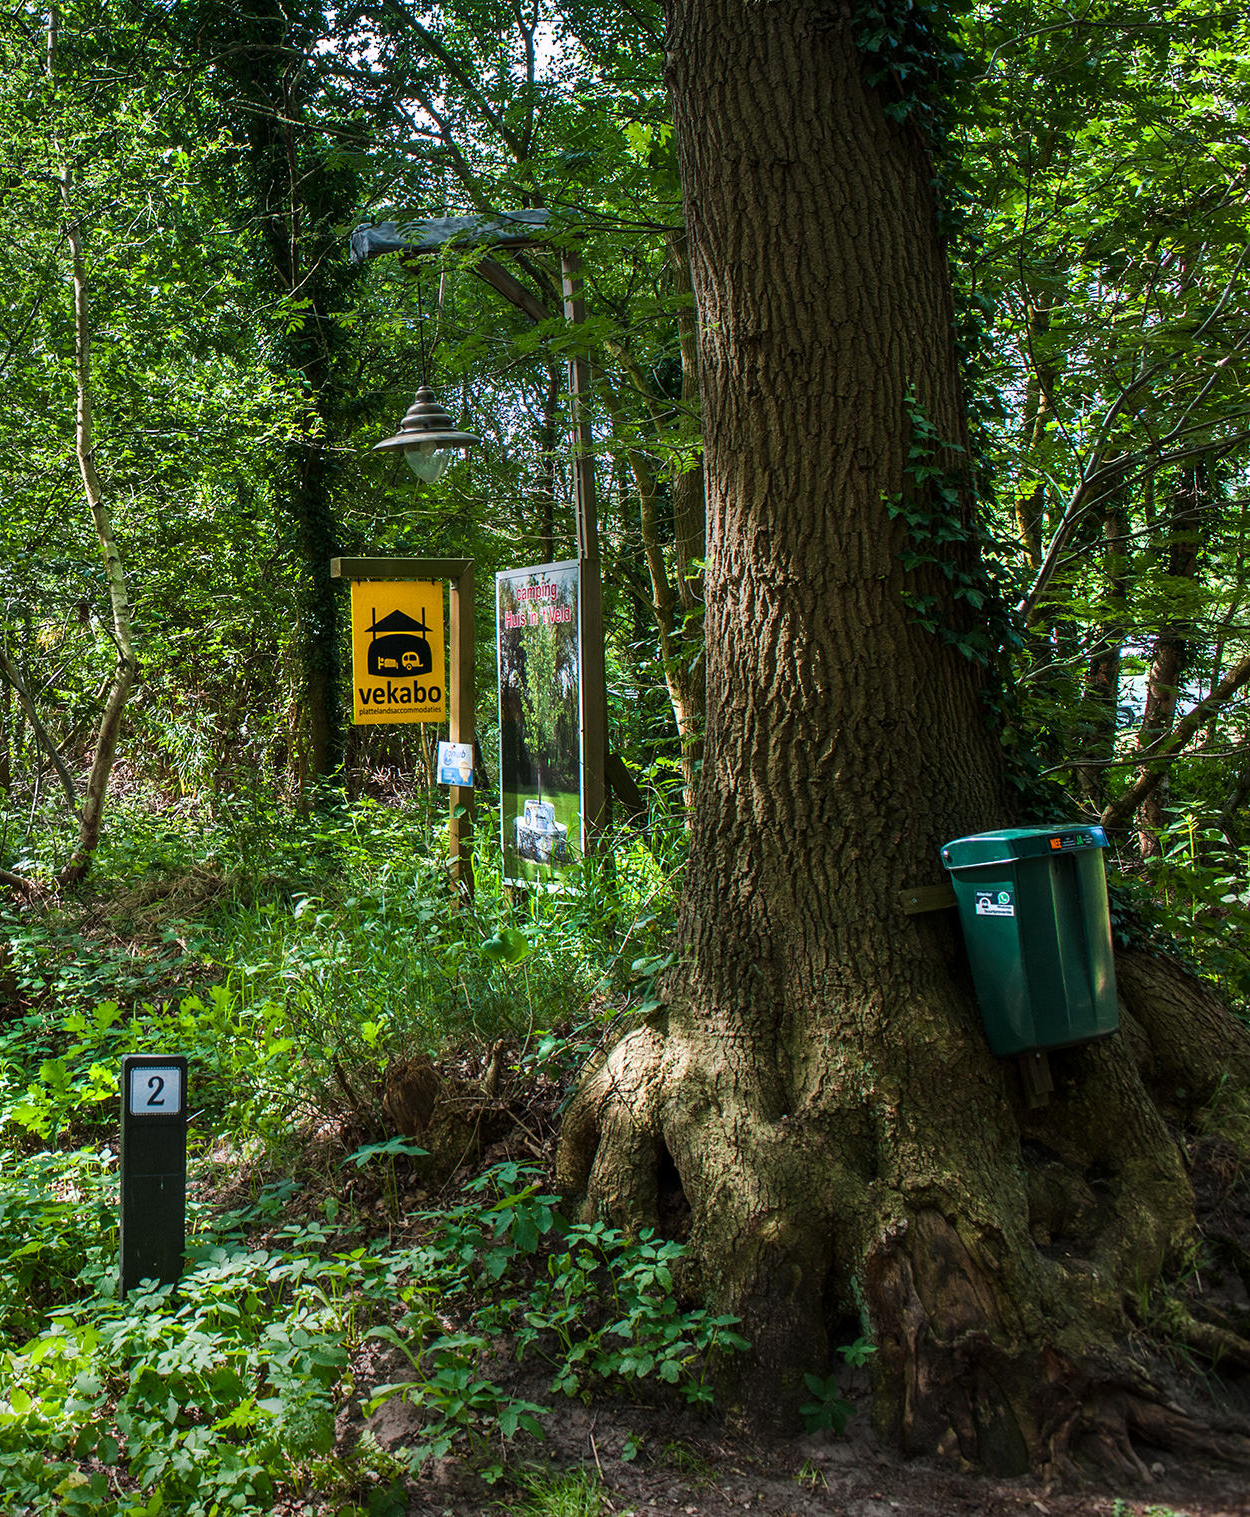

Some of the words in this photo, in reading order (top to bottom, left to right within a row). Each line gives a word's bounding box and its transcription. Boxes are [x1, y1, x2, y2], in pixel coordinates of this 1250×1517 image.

[516, 581, 557, 601] camping
[505, 610, 526, 629] Huis
[528, 609, 538, 626] in
[548, 604, 571, 623] Veld
[358, 680, 442, 704] vekabo
[358, 706, 442, 716] plattelandsaccommodaties
[147, 1075, 165, 1107] 2
